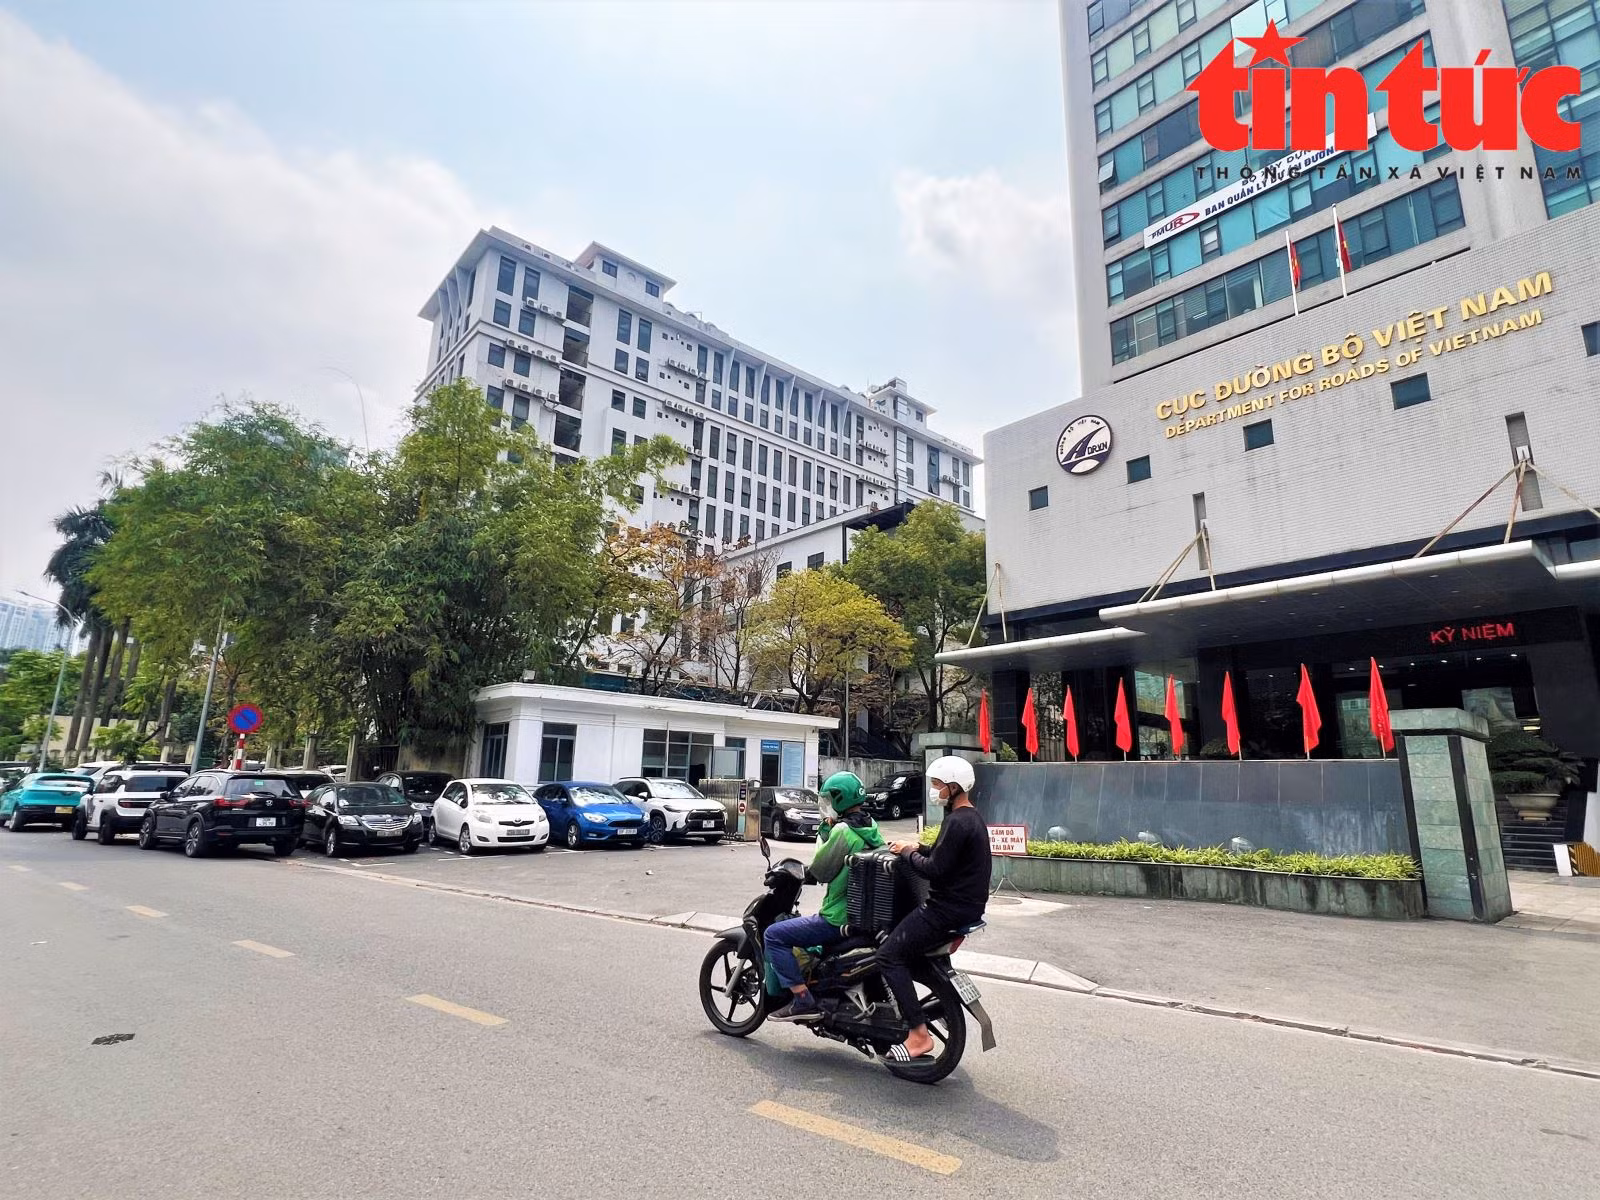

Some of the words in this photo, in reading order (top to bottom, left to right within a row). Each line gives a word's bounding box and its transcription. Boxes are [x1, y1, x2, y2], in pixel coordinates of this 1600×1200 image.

[1204, 200, 1226, 216] BAN
[1227, 186, 1254, 205] QUẢN
[1155, 388, 1206, 420] CỤC
[1213, 353, 1315, 402] ĐƯỜNG
[1321, 332, 1365, 367] BỘ
[1371, 305, 1449, 348] VIỆT
[1459, 271, 1554, 322] NAM
[1165, 394, 1275, 439] DEPARTMENT
[1279, 382, 1316, 404] FOR
[1319, 358, 1391, 392] ROADS
[1395, 348, 1424, 368] OF
[1428, 308, 1544, 357] VIETNAM
